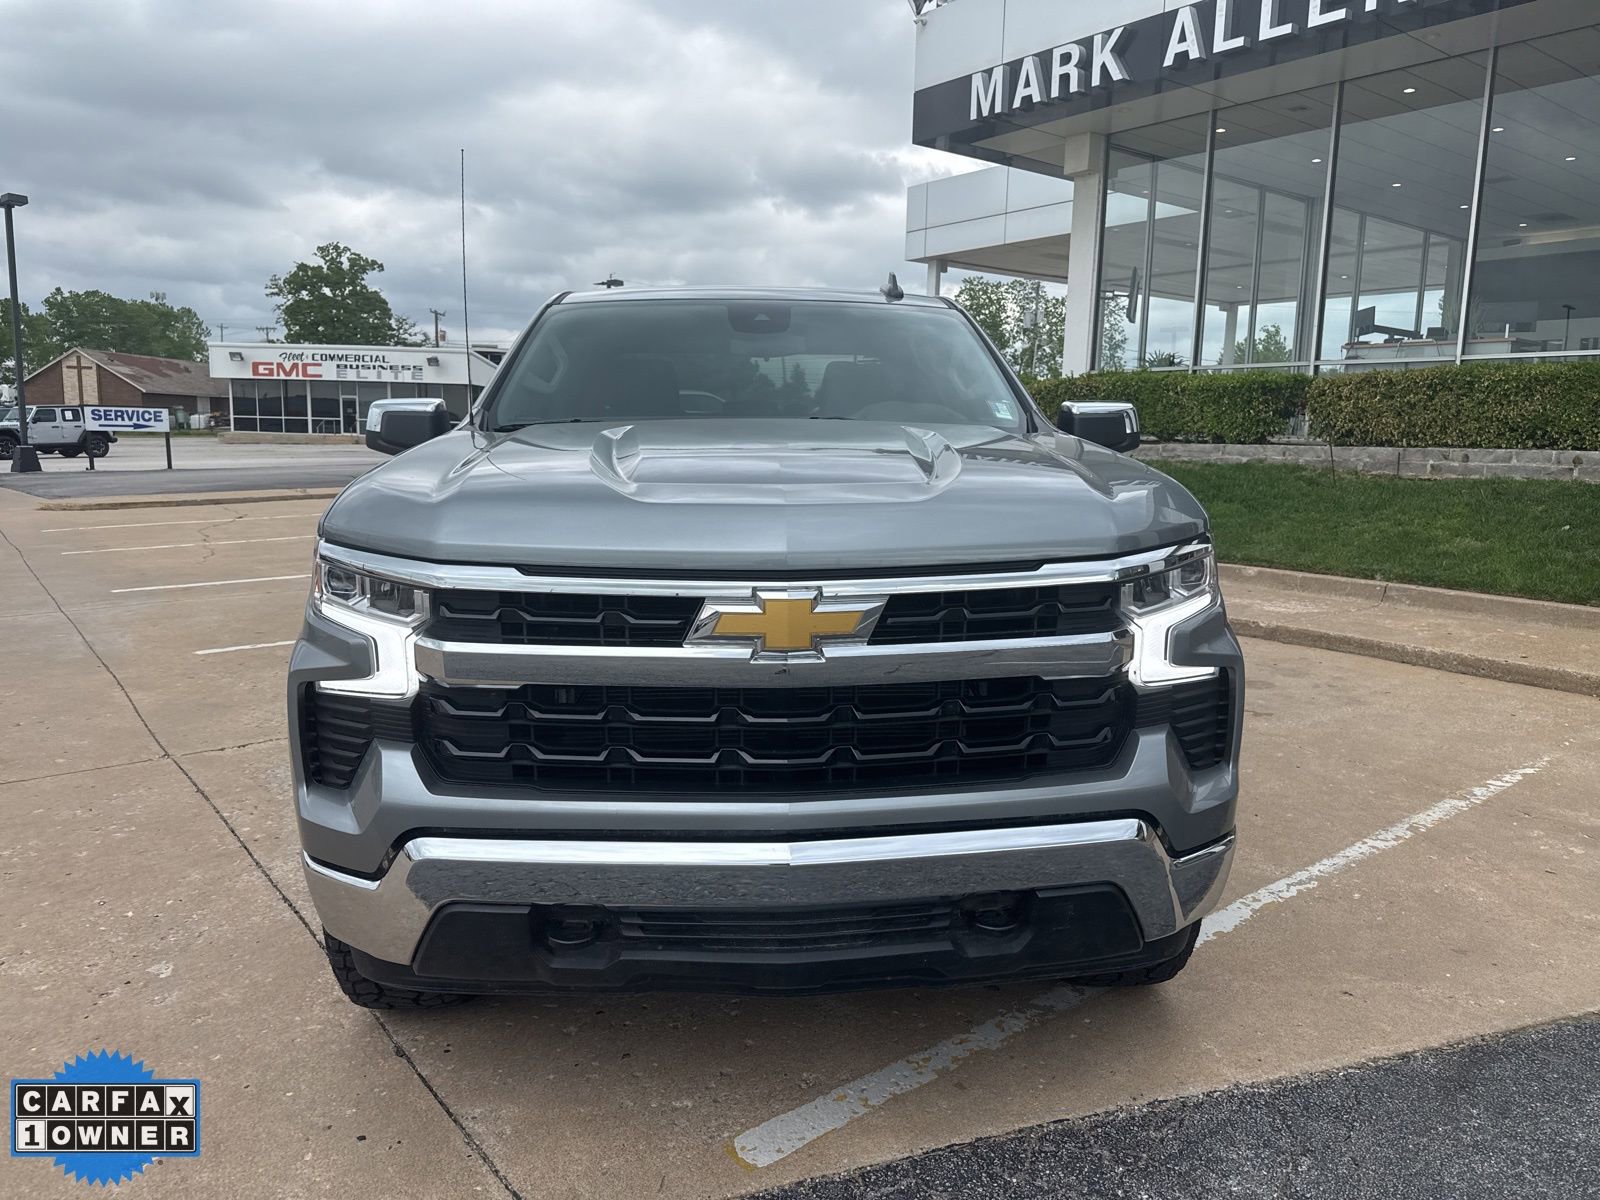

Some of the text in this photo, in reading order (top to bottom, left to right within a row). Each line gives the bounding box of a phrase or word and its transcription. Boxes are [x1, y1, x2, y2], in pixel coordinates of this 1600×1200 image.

[970, 0, 1413, 120] MARK ALL
[279, 352, 304, 362] Fleet
[311, 353, 390, 363] COMMERCIAL
[252, 361, 323, 378] GMC
[336, 363, 423, 371] BUSINESS
[336, 369, 423, 380] ELITE
[90, 408, 163, 422] SERVICE
